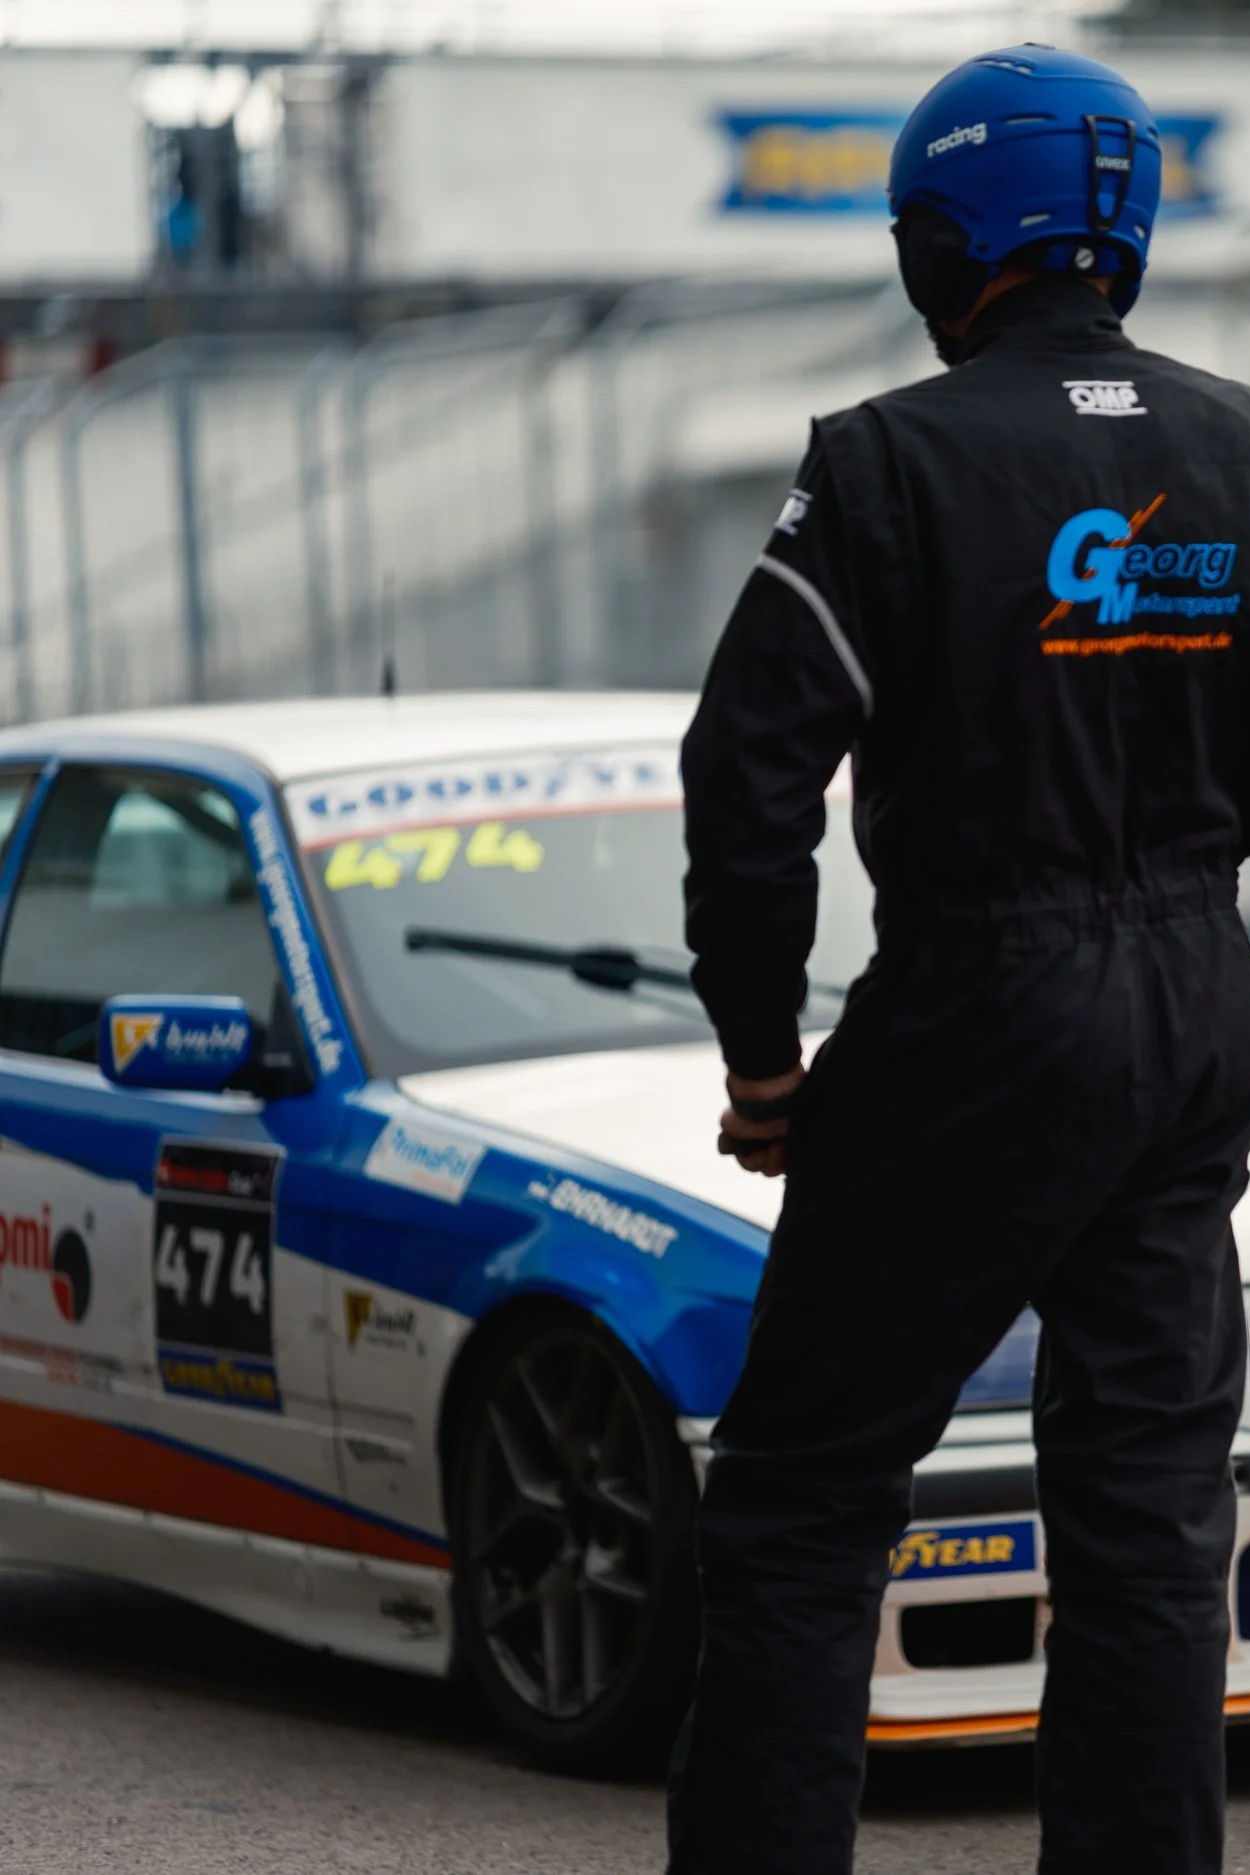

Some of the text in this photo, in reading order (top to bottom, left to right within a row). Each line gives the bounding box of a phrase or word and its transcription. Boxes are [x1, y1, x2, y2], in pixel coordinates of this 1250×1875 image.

[927, 122, 987, 158] racing
[1096, 156, 1131, 171] uvex
[1067, 384, 1141, 411] OMP
[1046, 507, 1238, 604] Georg
[1097, 582, 1241, 625] Motorsport
[1040, 632, 1232, 657] www.georgmotorsport.de
[306, 757, 684, 820] GOODYE
[325, 821, 545, 892] 474
[155, 1222, 266, 1316] 474
[888, 1531, 1015, 1578] YEAR
